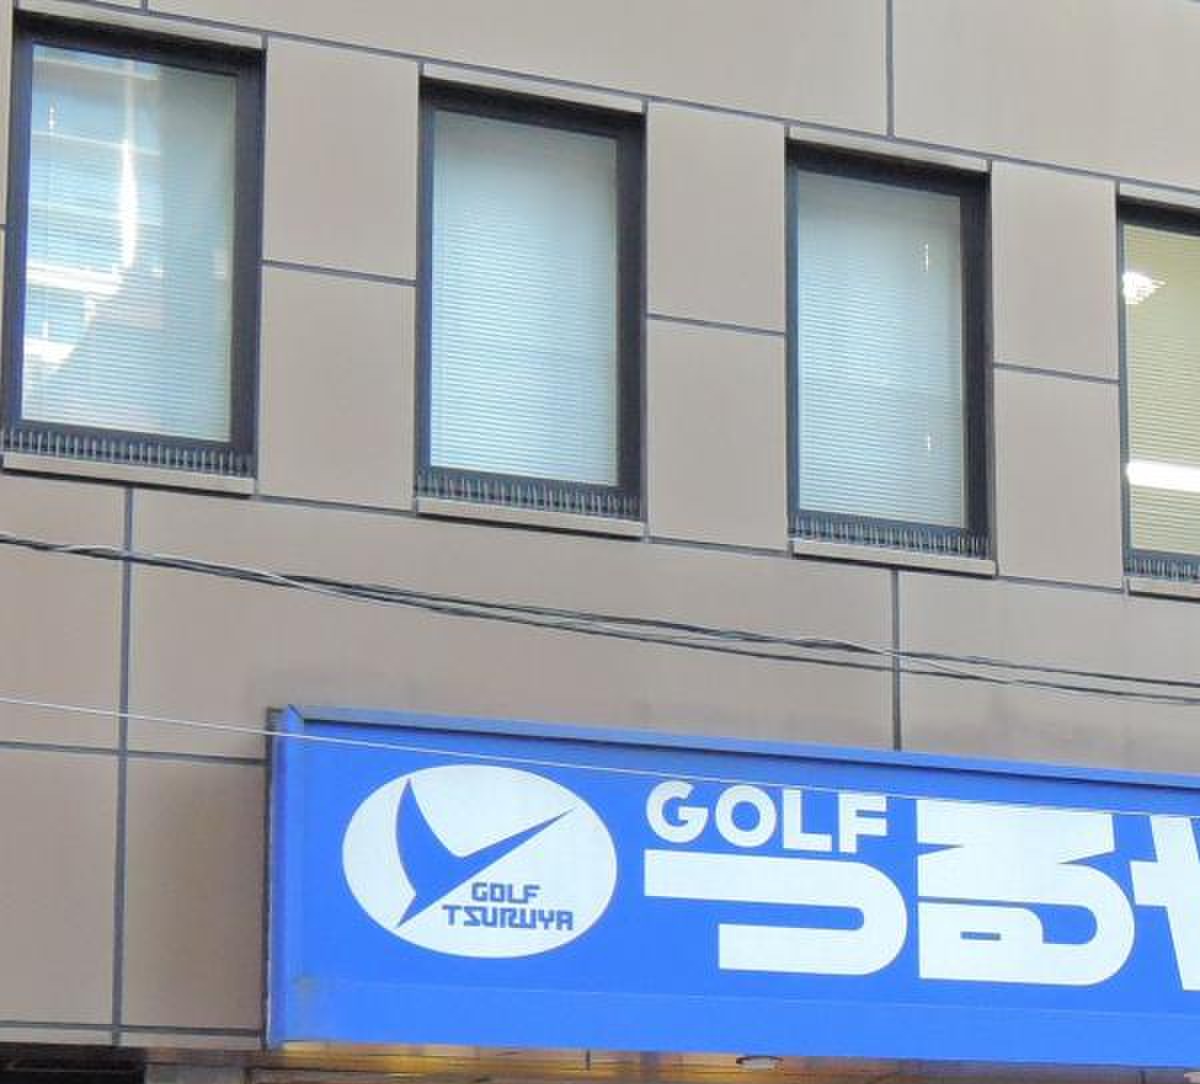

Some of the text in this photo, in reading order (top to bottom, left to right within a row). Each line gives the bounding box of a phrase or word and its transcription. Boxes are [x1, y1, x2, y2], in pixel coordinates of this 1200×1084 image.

[645, 780, 888, 854] GOLF
[471, 881, 541, 904] GOLF
[441, 904, 574, 931] TSURUYA
